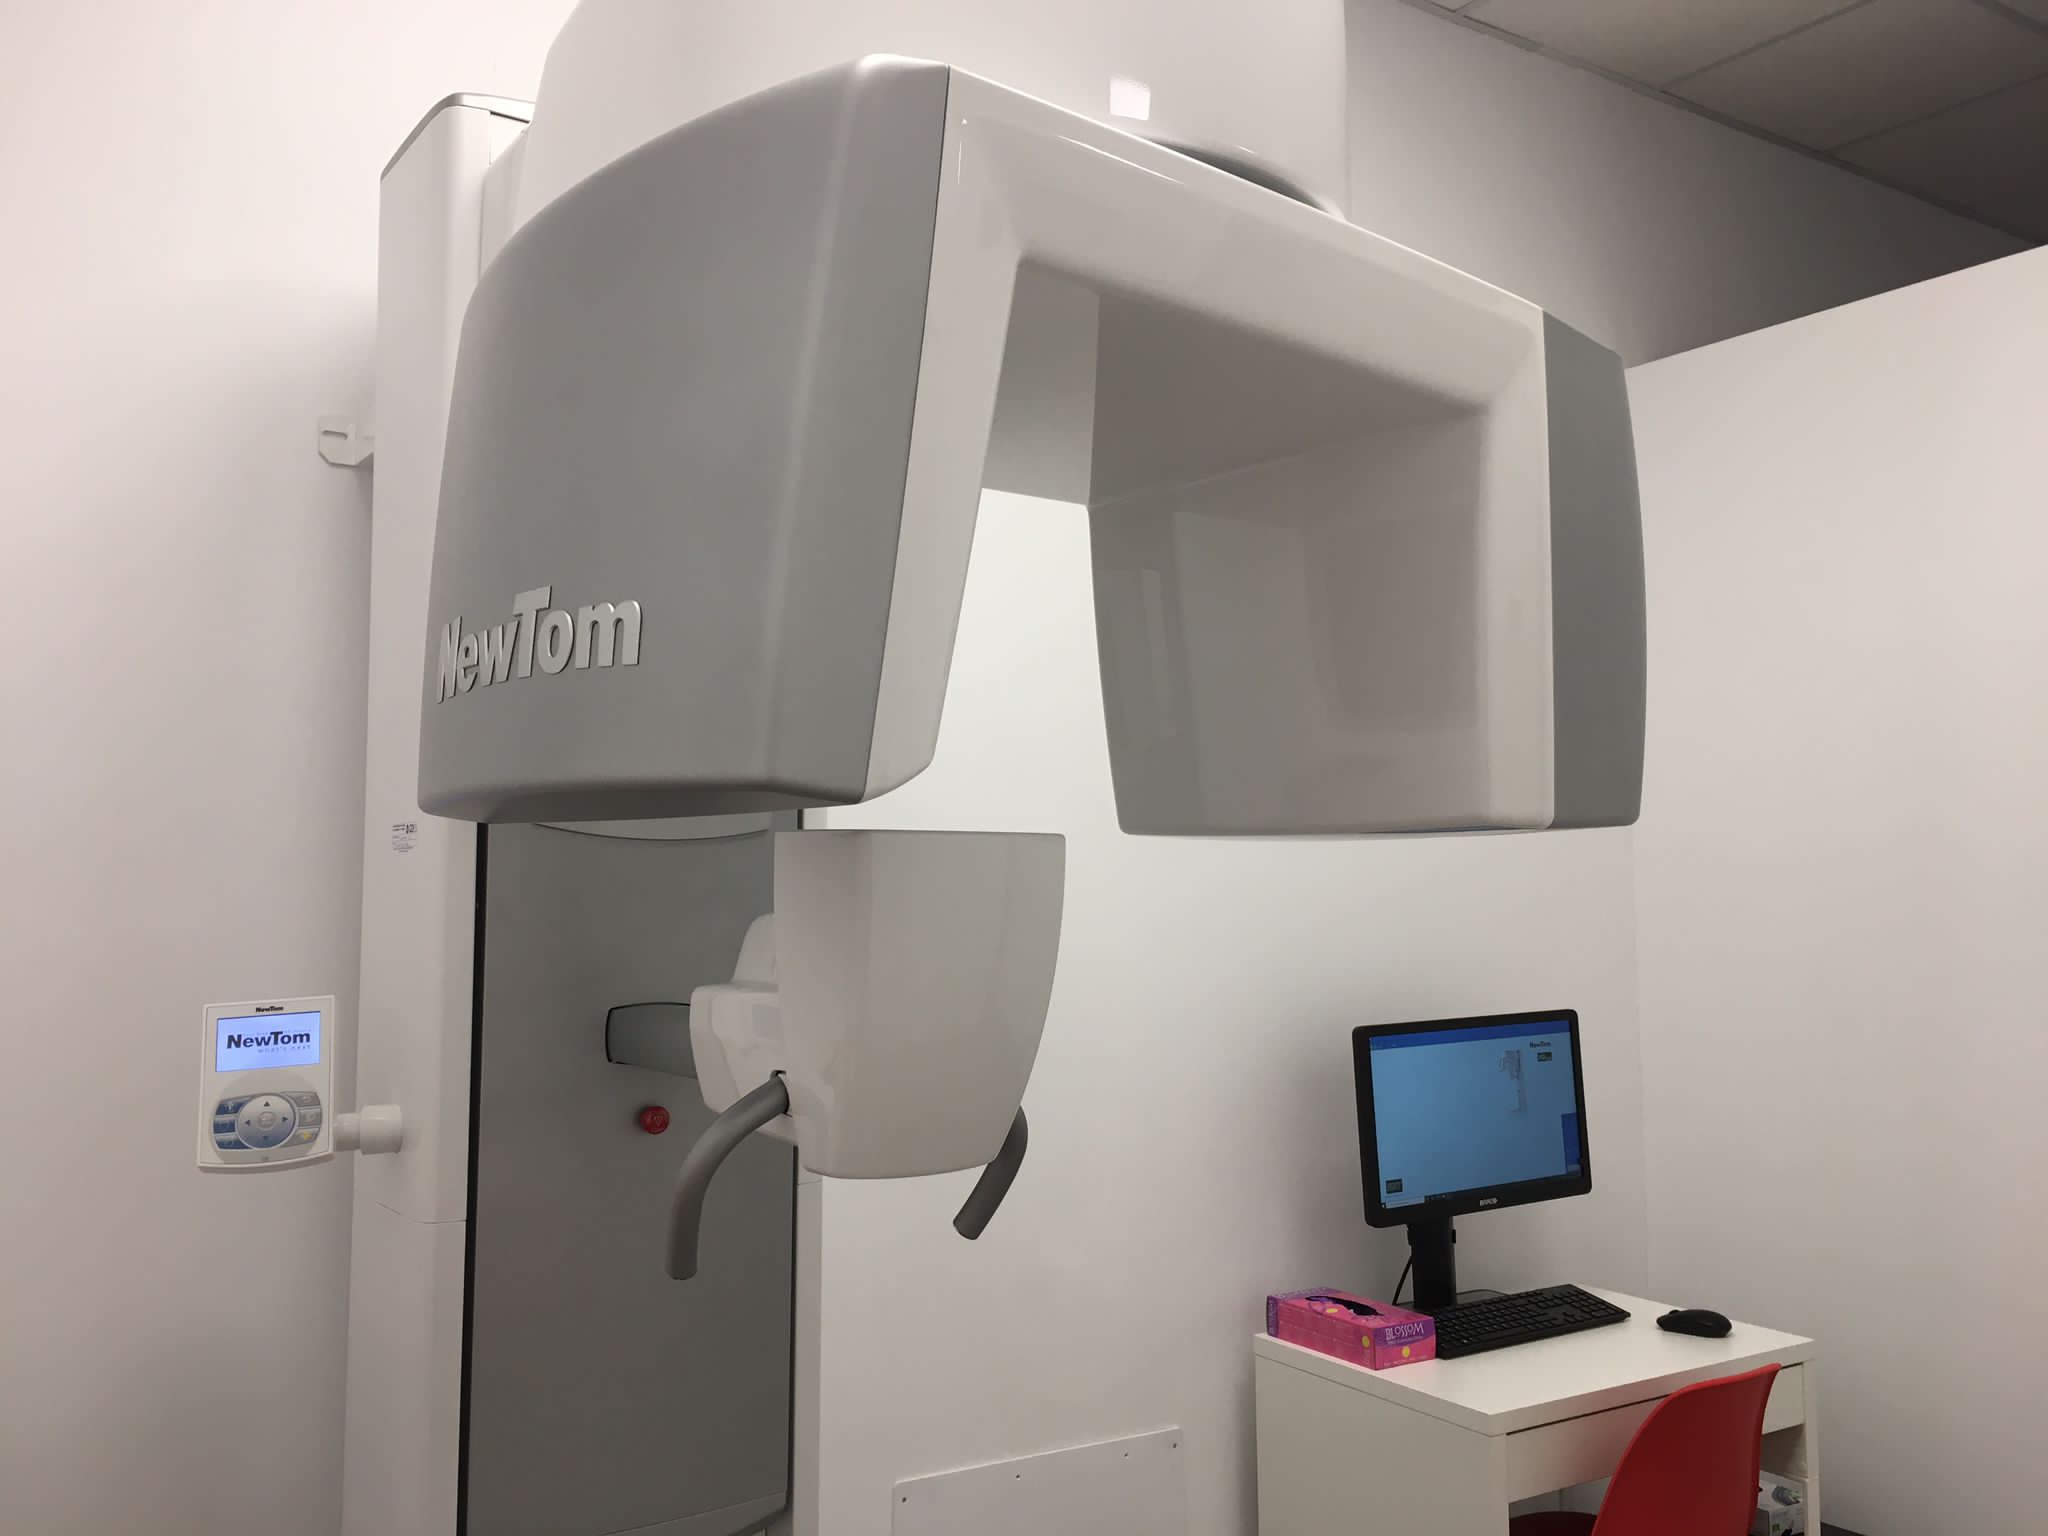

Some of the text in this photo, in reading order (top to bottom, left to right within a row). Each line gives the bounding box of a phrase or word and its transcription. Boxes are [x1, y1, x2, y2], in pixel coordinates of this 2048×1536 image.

[437, 584, 643, 704] NewTom
[226, 1030, 311, 1049] NewTom
[1385, 1322, 1424, 1341] BLOSSOM
